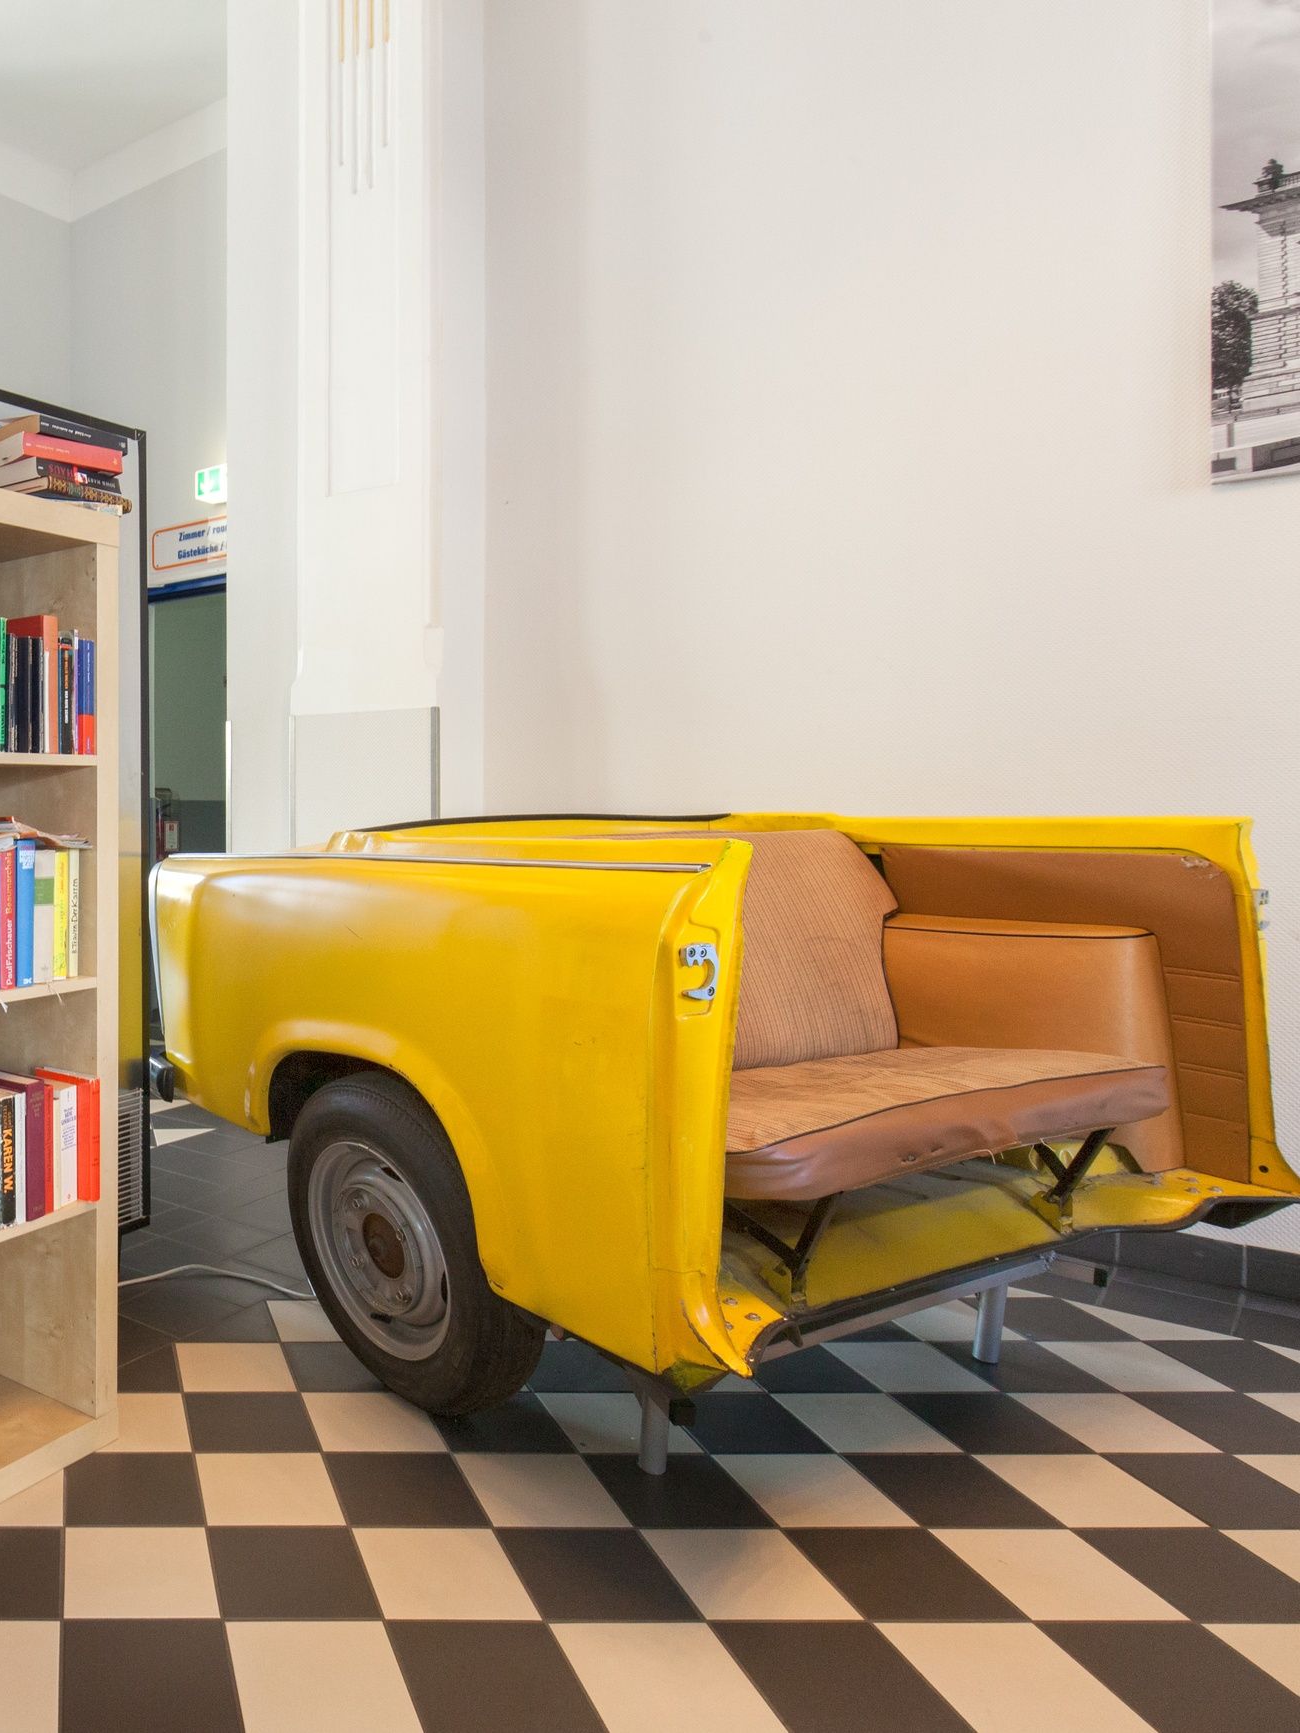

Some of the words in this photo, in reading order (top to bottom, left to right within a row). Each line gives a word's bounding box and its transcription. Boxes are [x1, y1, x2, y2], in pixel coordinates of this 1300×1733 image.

[179, 529, 206, 542] Zimmer
[177, 543, 218, 559] Gästeküche
[5, 918, 13, 965] Frischauer
[3, 1129, 13, 1173] KAREN
